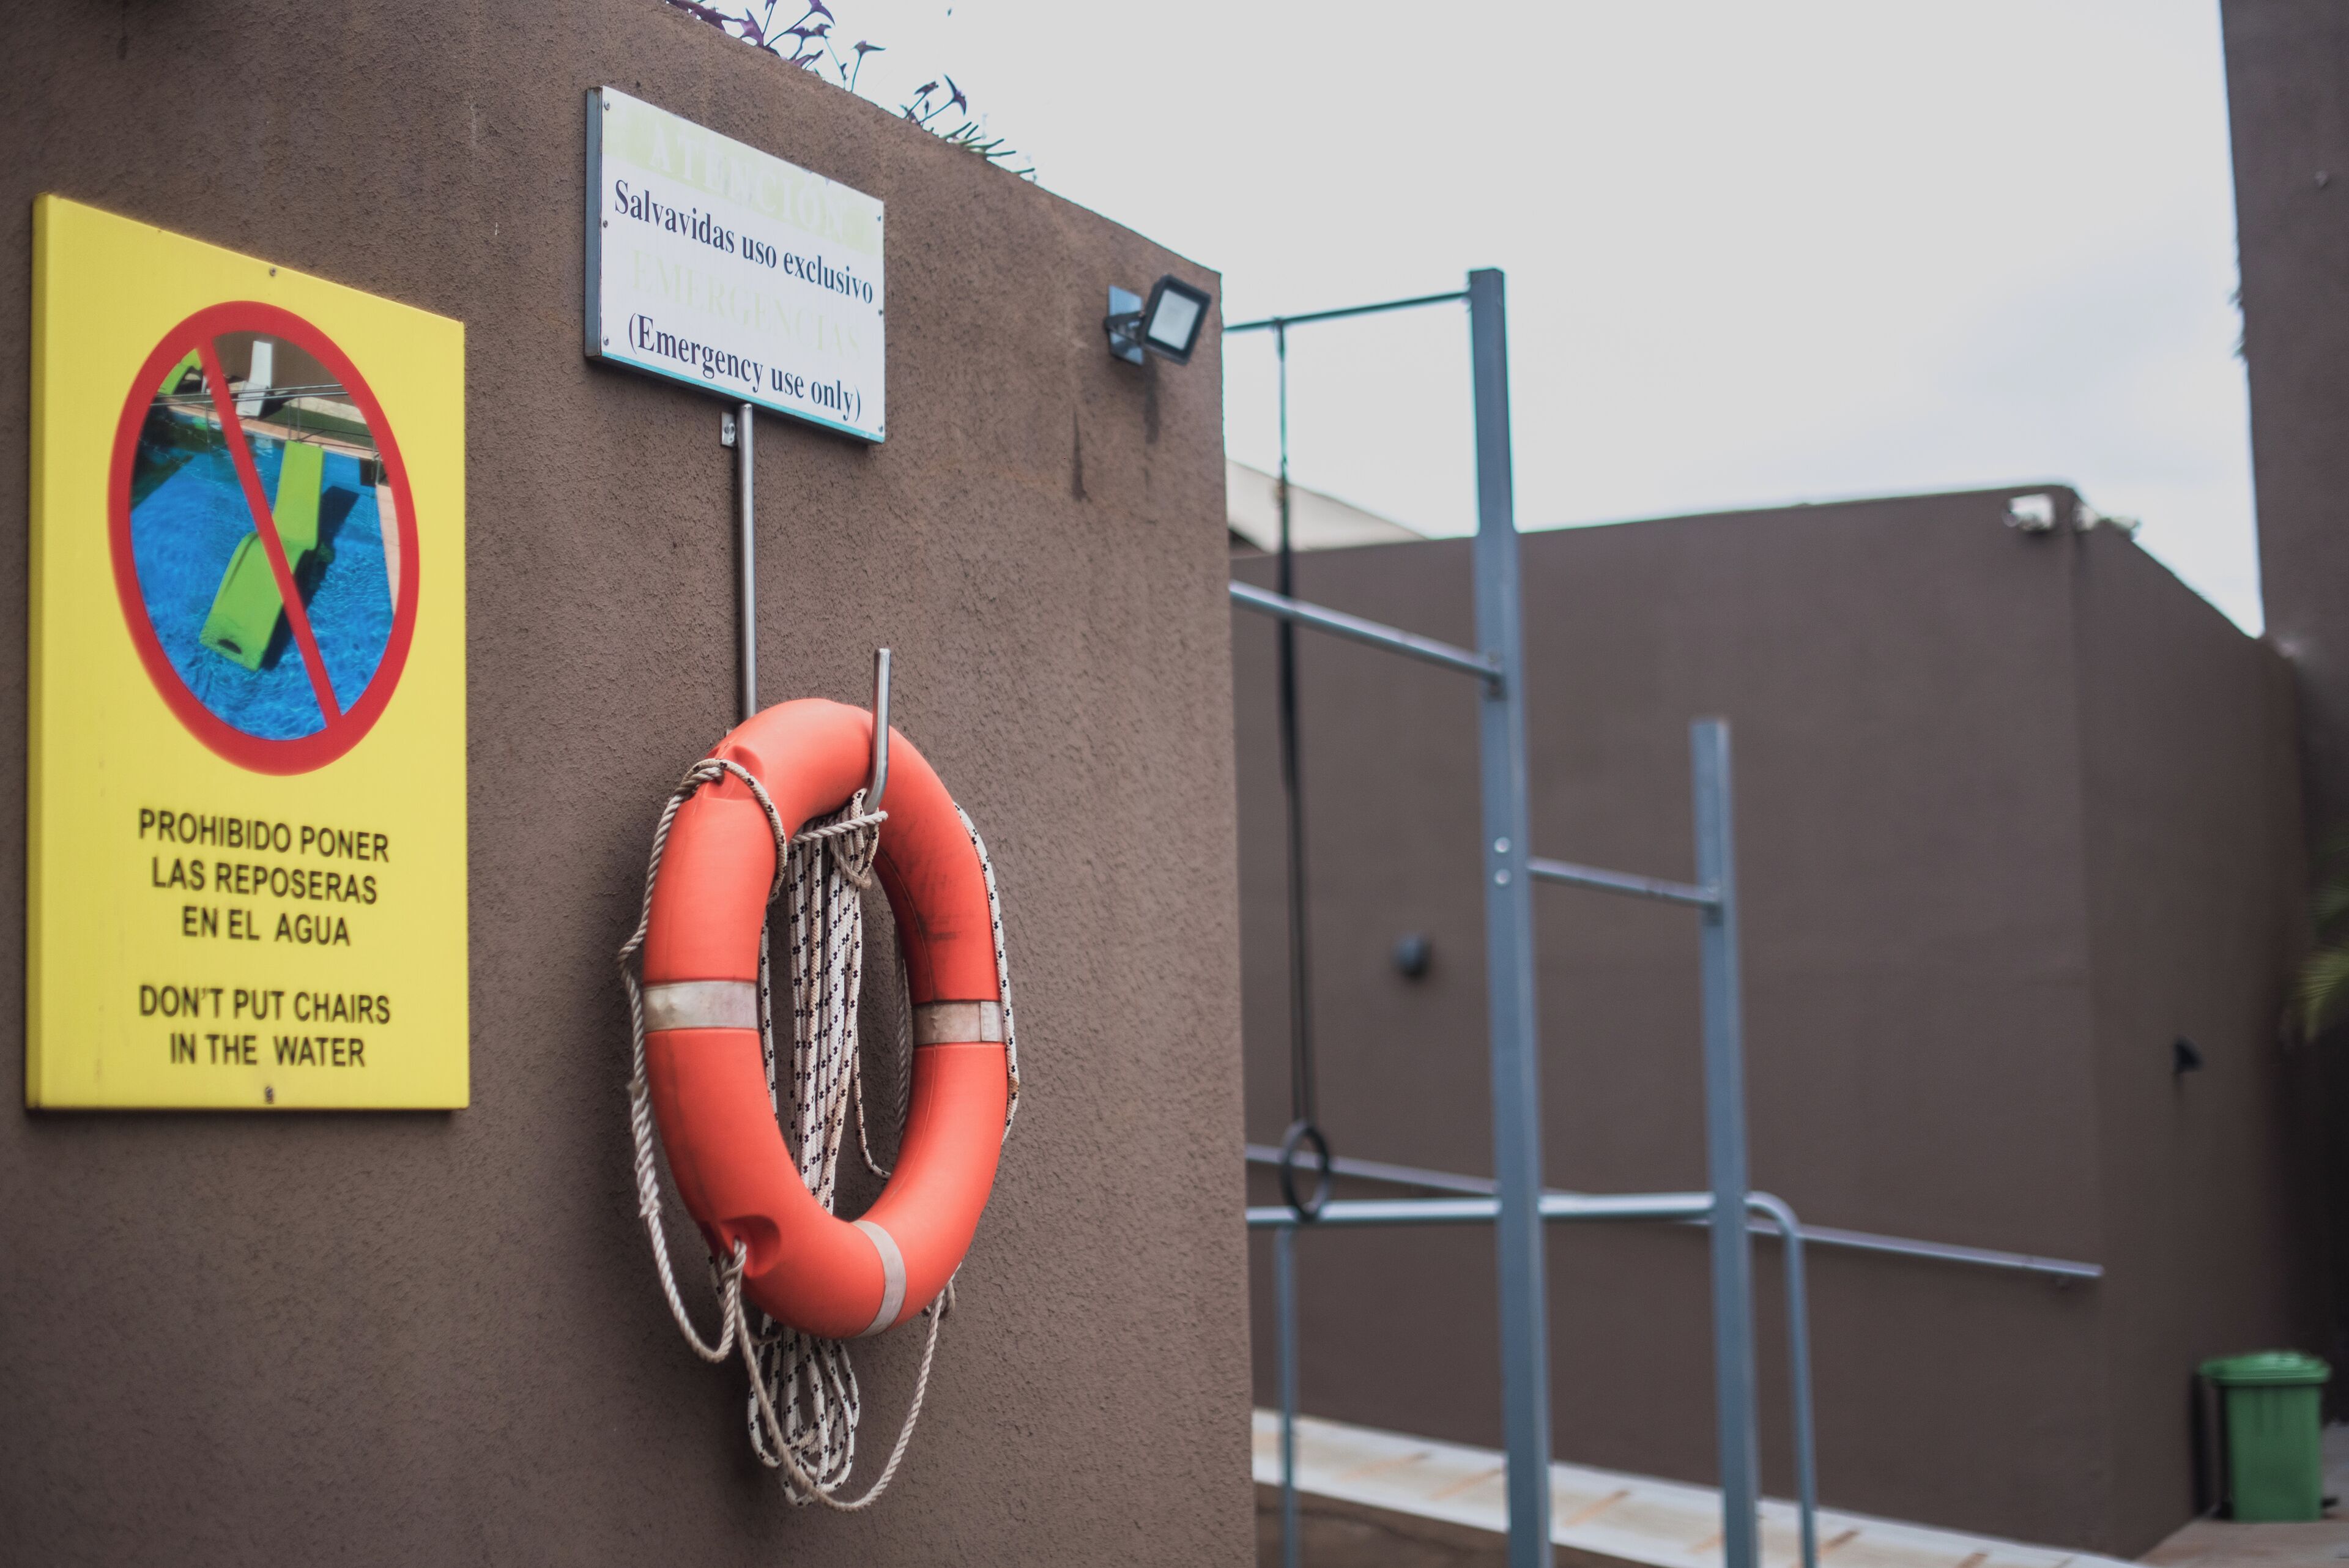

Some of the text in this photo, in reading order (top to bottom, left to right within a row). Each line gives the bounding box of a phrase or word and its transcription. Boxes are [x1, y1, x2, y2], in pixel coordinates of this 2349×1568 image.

[615, 179, 873, 304] Salvavidas uso exclusivo
[631, 248, 860, 360] EMERGENCIAS
[629, 312, 861, 423] (Emergency use only)
[139, 808, 389, 862] PROHIBIDO PONER
[152, 856, 377, 904] LAS REPOSERAS
[182, 905, 351, 946] EN EL AGUA
[139, 985, 390, 1024] DON'T PUT CHAIRS
[169, 1033, 366, 1067] IN THE WATER
